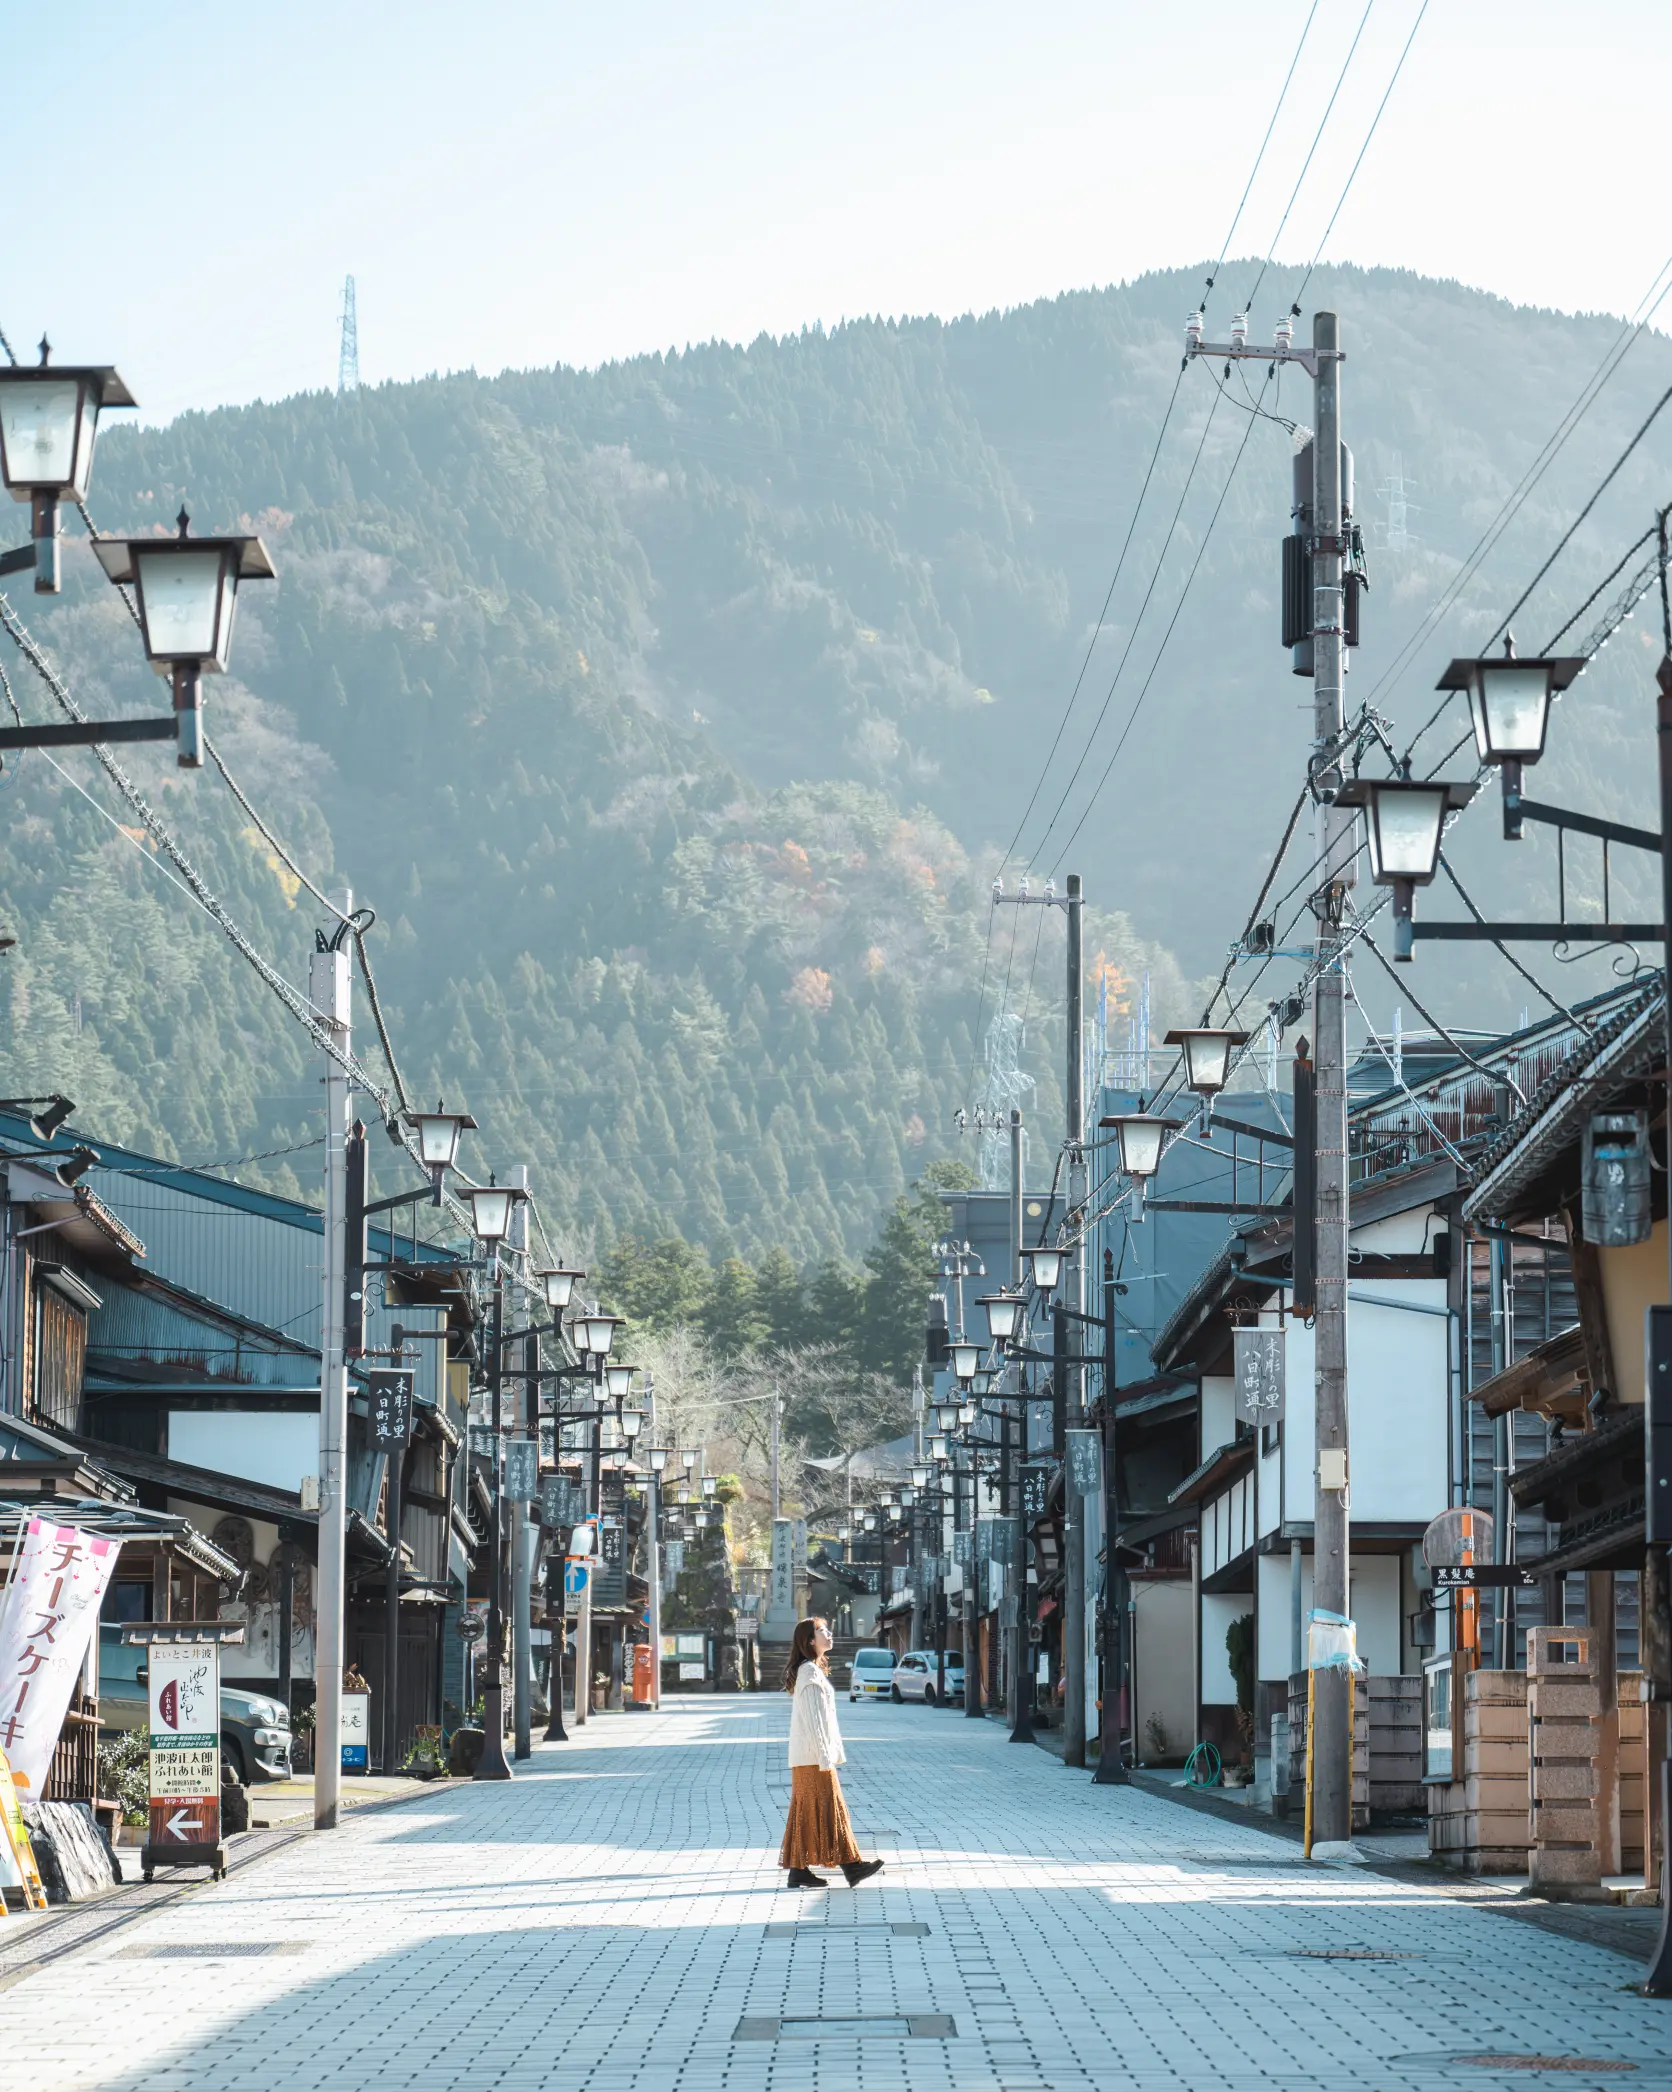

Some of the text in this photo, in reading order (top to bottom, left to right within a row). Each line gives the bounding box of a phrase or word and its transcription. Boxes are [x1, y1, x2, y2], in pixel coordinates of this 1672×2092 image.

[1241, 1350, 1266, 1416] 八日町通り
[1265, 1337, 1280, 1409] 木彫りの里
[376, 1387, 392, 1445] 八日町通り
[393, 1376, 408, 1438] 木彫りの里
[1023, 1478, 1035, 1517] 八日町通り
[1036, 1470, 1046, 1513] 木彫りの里
[0, 1543, 83, 1749] チーズケーキ
[153, 1648, 212, 1660] よいとこ井波
[164, 1691, 173, 1722] ふれあい館
[154, 1751, 213, 1765] 池波正太郎
[154, 1764, 213, 1777] ふれあい館
